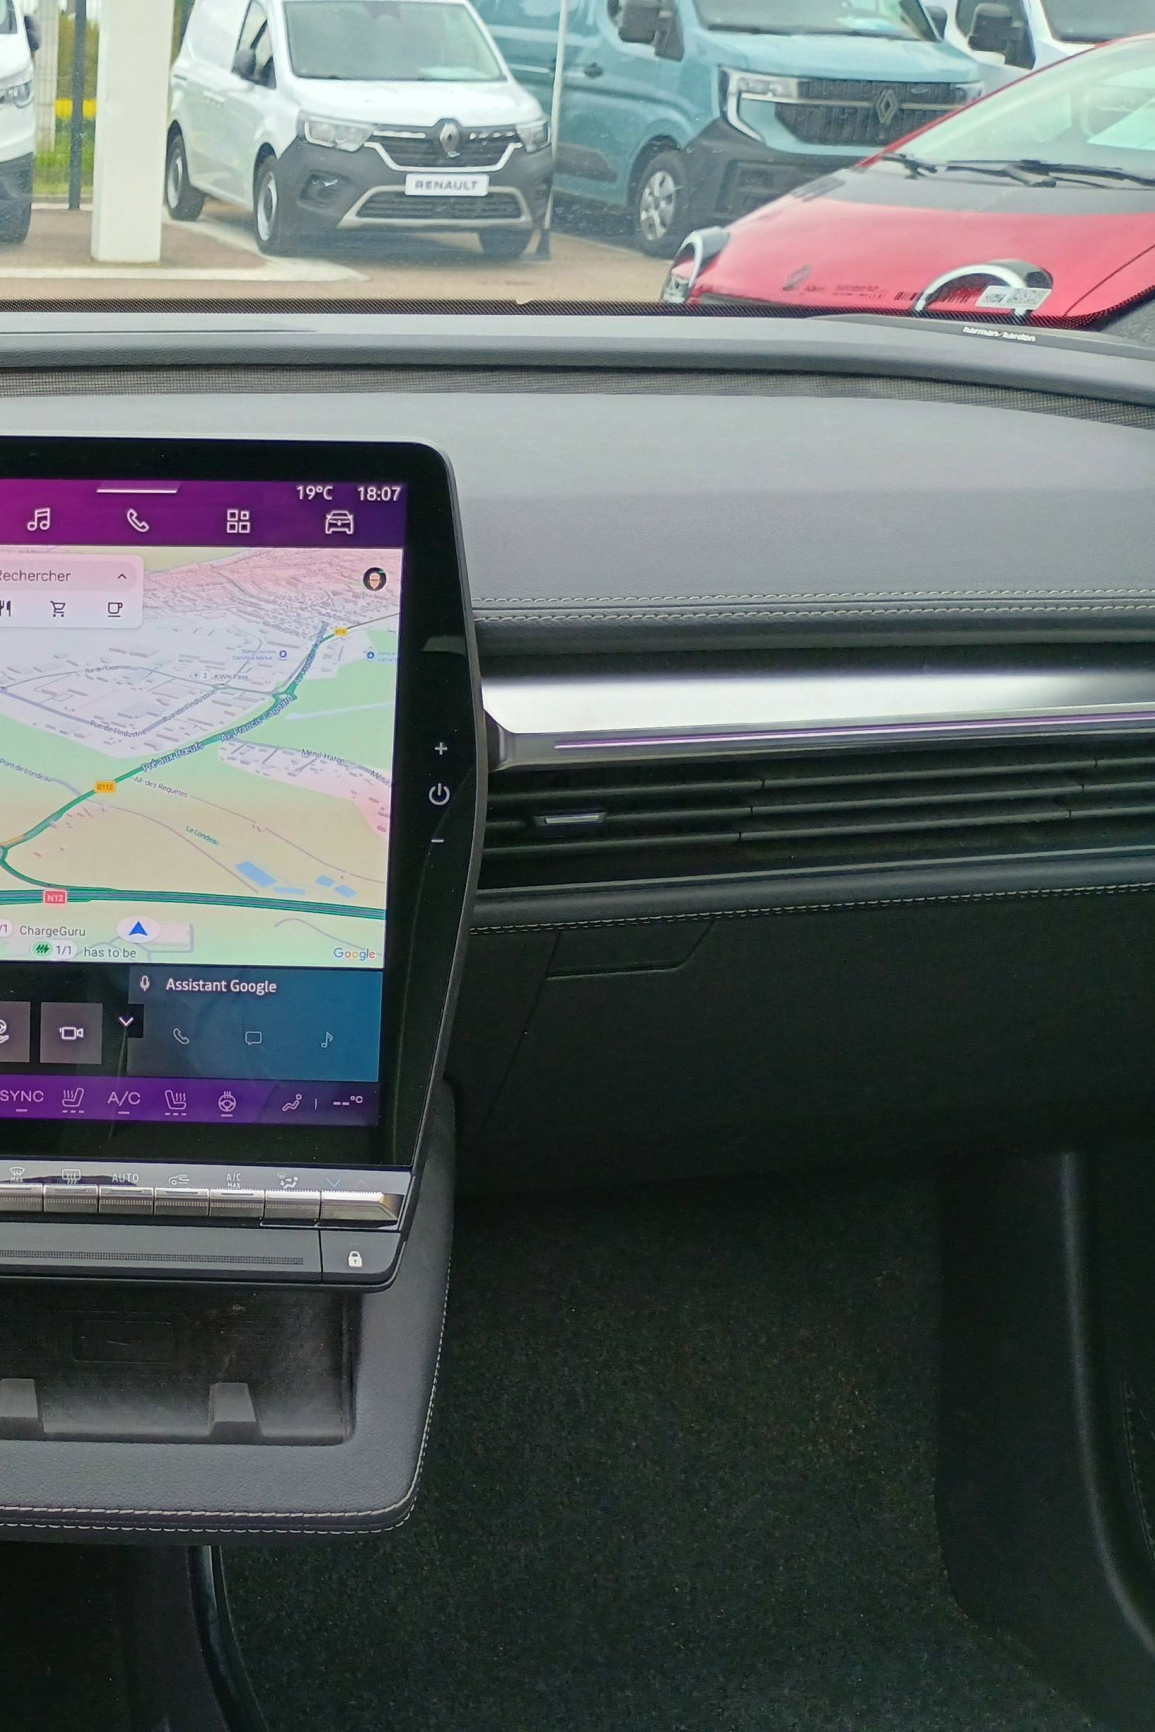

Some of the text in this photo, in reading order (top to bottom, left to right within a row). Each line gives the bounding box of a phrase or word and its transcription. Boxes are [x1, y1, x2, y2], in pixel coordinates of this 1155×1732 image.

[414, 180, 479, 191] RENAULT
[357, 486, 401, 502] 18:07
[233, 716, 264, 737] Francis
[0, 758, 15, 769] Pont
[141, 757, 159, 773] Pré
[158, 753, 175, 766] aux
[96, 783, 114, 792] D112
[144, 778, 158, 789] des
[47, 893, 64, 904] N12
[19, 925, 87, 940] ChargeGuru
[55, 945, 73, 956] 1/1
[333, 947, 376, 962] Google
[165, 978, 277, 996] Assistant Google
[0, 1089, 45, 1103] SYNC
[107, 1091, 141, 1106] A/C
[111, 1173, 139, 1183] AUTO
[226, 1173, 241, 1182] A/C
